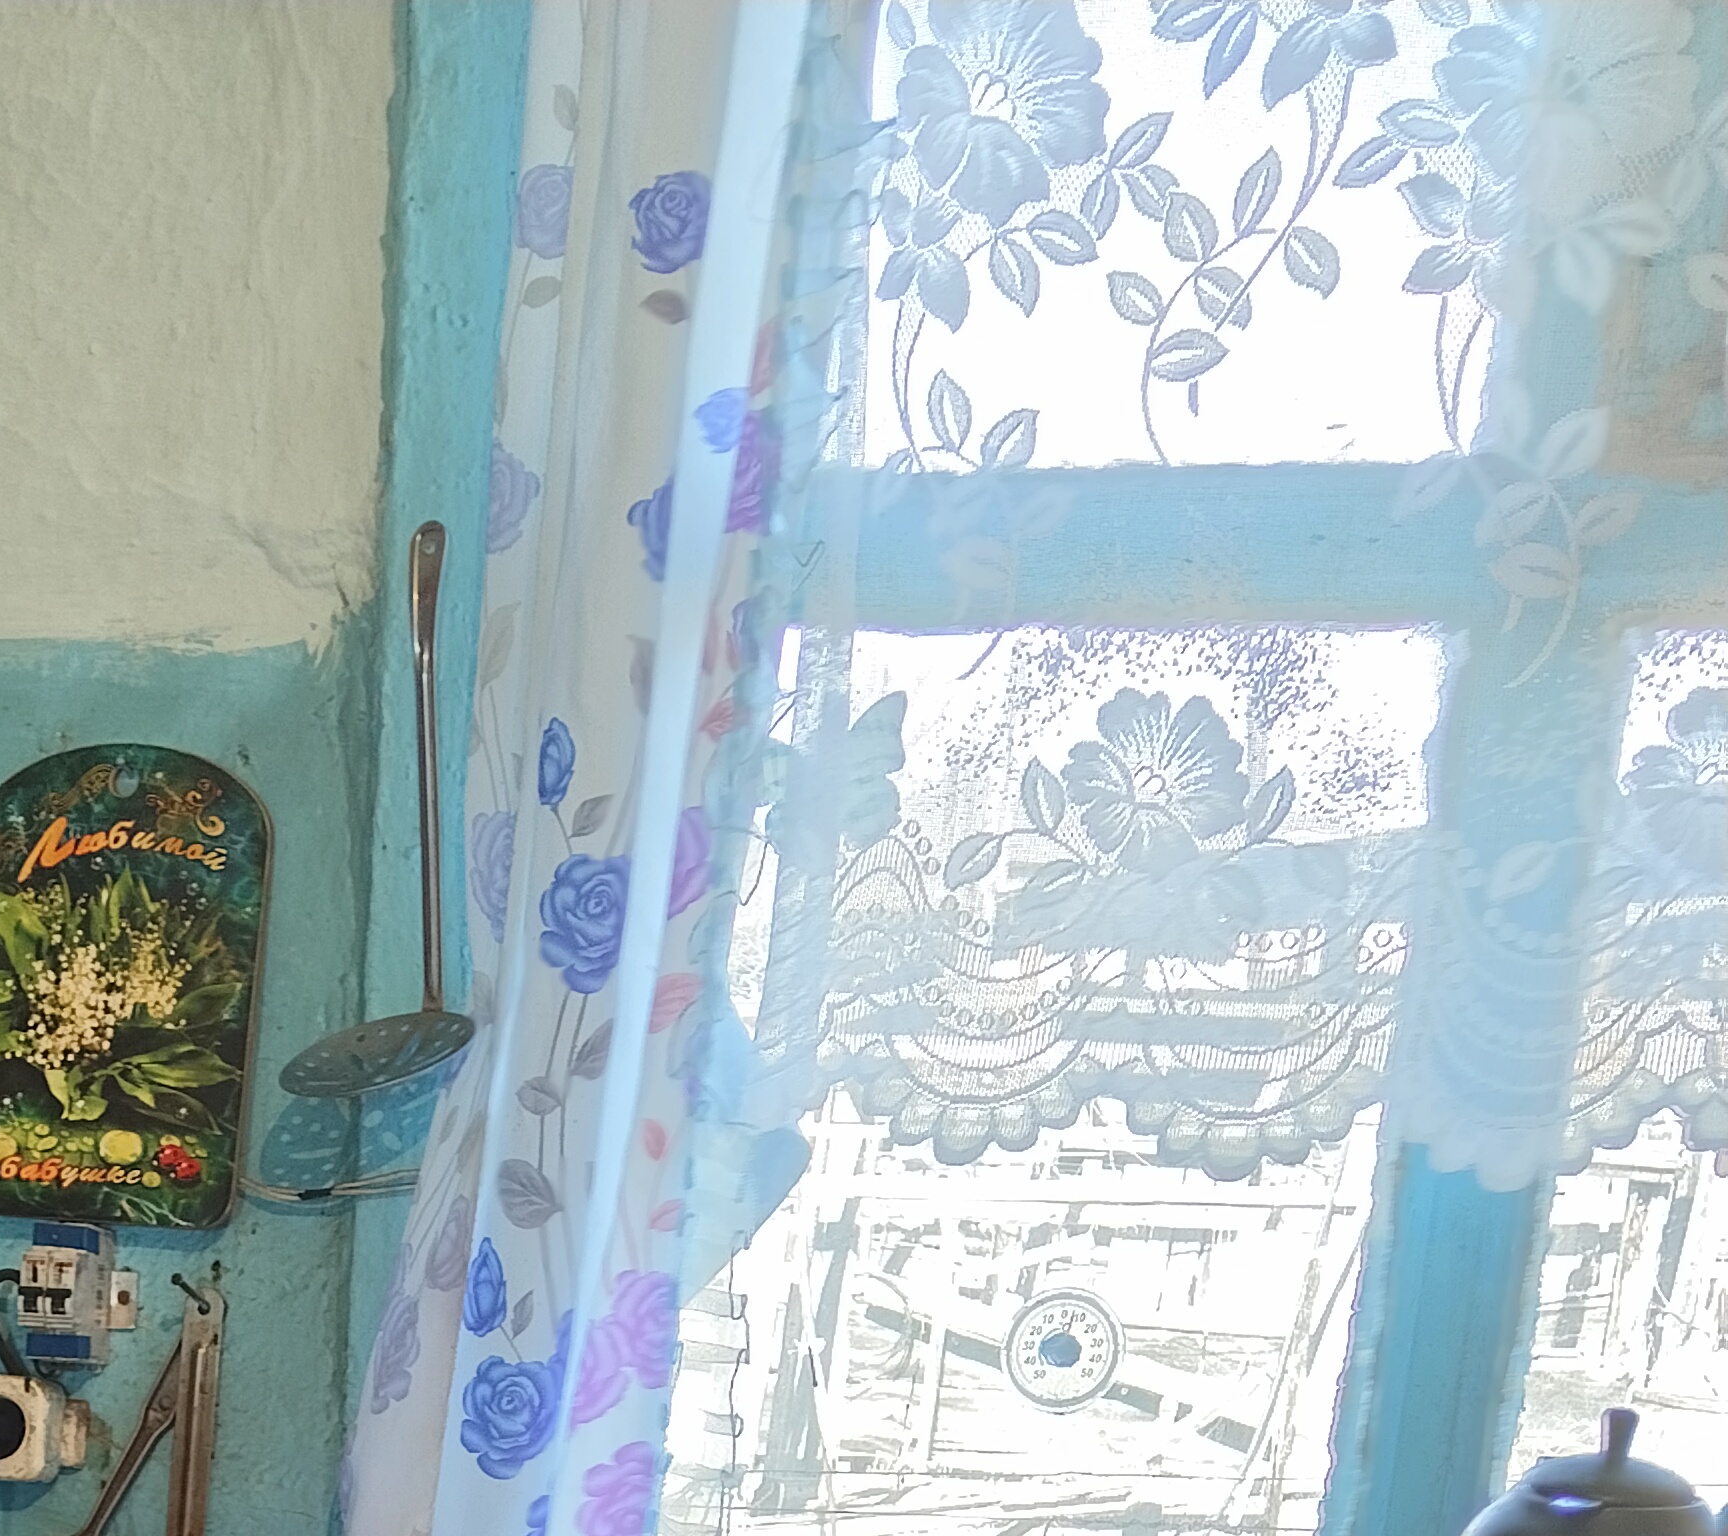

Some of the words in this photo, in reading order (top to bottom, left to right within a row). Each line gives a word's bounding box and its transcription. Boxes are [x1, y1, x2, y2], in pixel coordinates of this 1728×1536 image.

[1061, 1309, 1068, 1319] 0
[1043, 1314, 1054, 1324] 10
[1030, 1326, 1042, 1335] 20
[1084, 1324, 1097, 1333] 20
[1022, 1341, 1035, 1350] 30
[1090, 1338, 1103, 1347] 30
[1024, 1356, 1036, 1365] 40
[1089, 1354, 1102, 1363] 40
[1033, 1370, 1046, 1379] 50
[1081, 1368, 1094, 1378] 50
